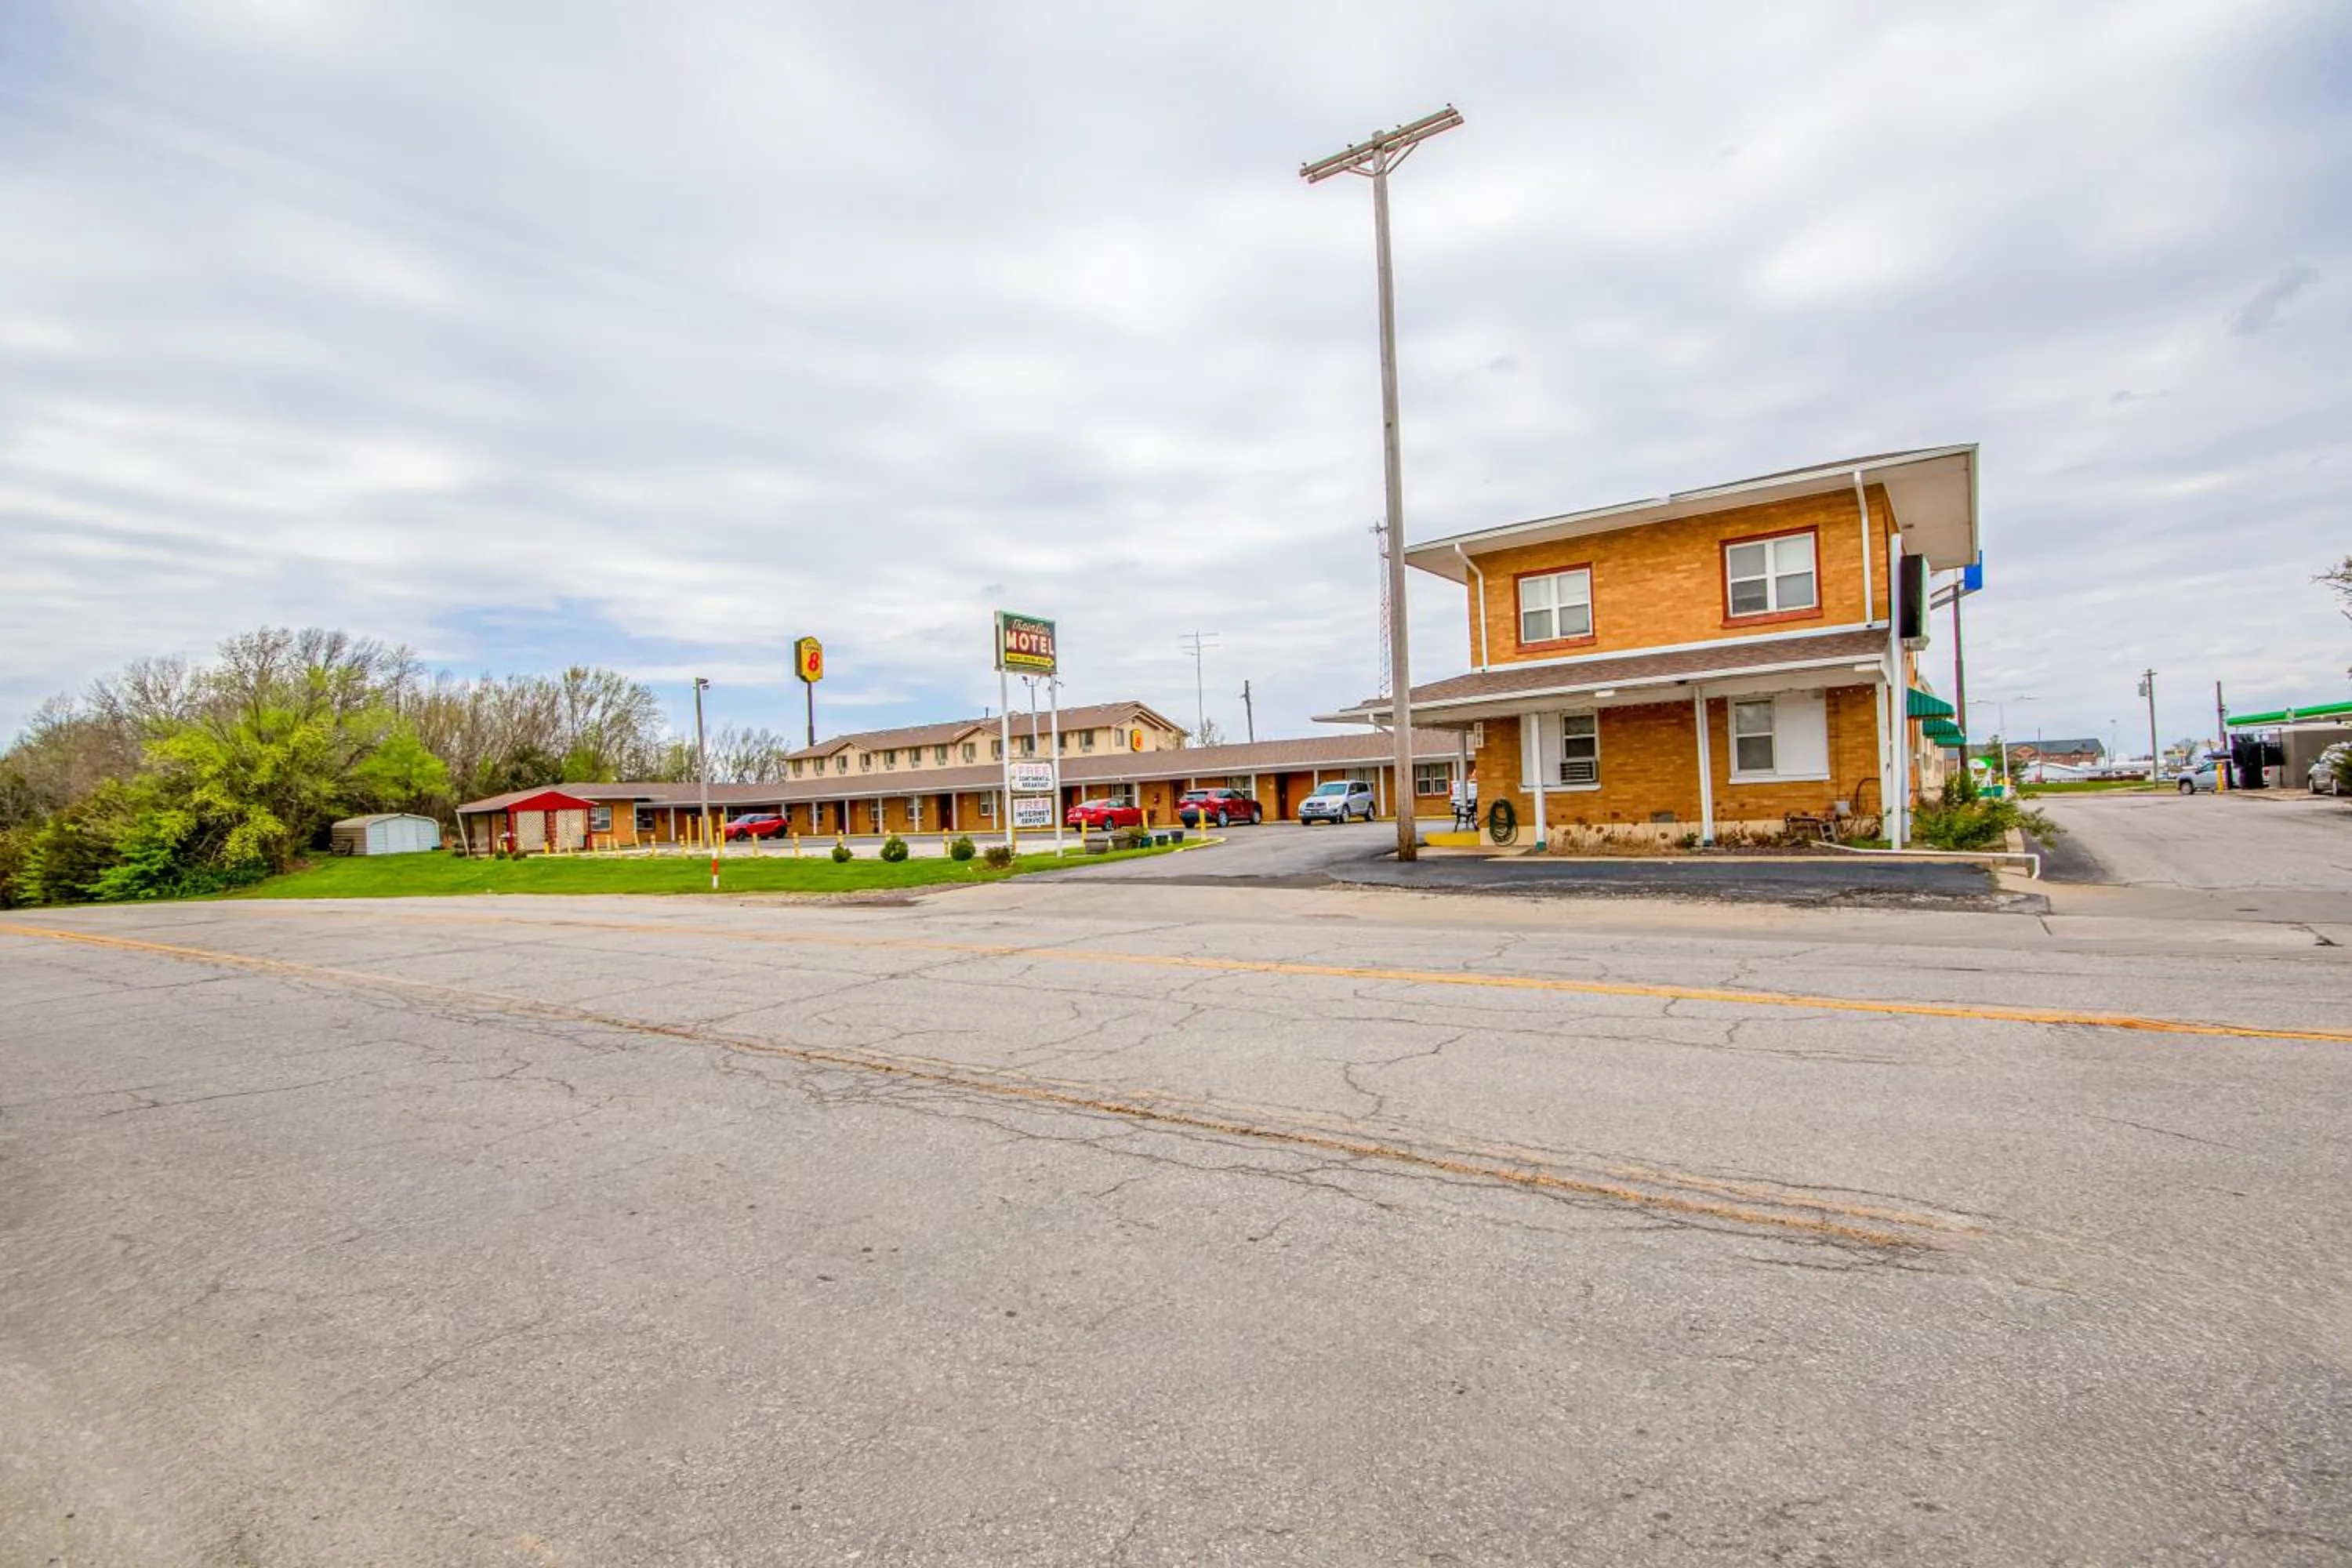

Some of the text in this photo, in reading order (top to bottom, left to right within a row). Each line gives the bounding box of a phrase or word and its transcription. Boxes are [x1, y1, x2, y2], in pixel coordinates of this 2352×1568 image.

[1006, 630, 1054, 655] MOTEL
[808, 652, 819, 672] 8
[1018, 767, 1049, 775] FREE
[1018, 800, 1049, 809] FREE
